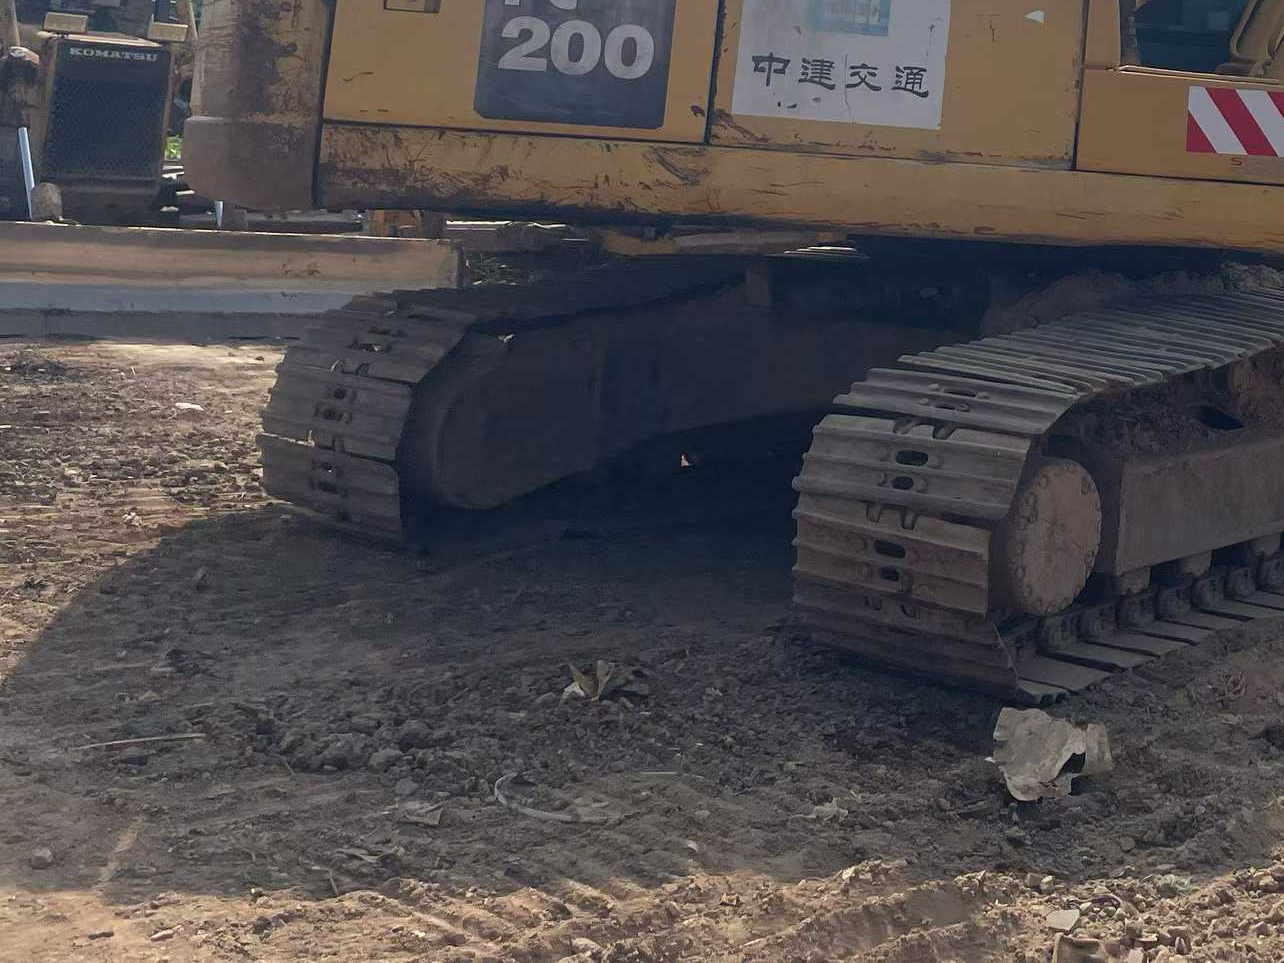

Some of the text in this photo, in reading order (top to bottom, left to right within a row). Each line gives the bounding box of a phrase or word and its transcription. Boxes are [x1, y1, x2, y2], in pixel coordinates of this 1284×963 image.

[69, 47, 158, 61] KOMATSU
[498, 16, 655, 79] 200
[751, 52, 929, 99] 中建交通
